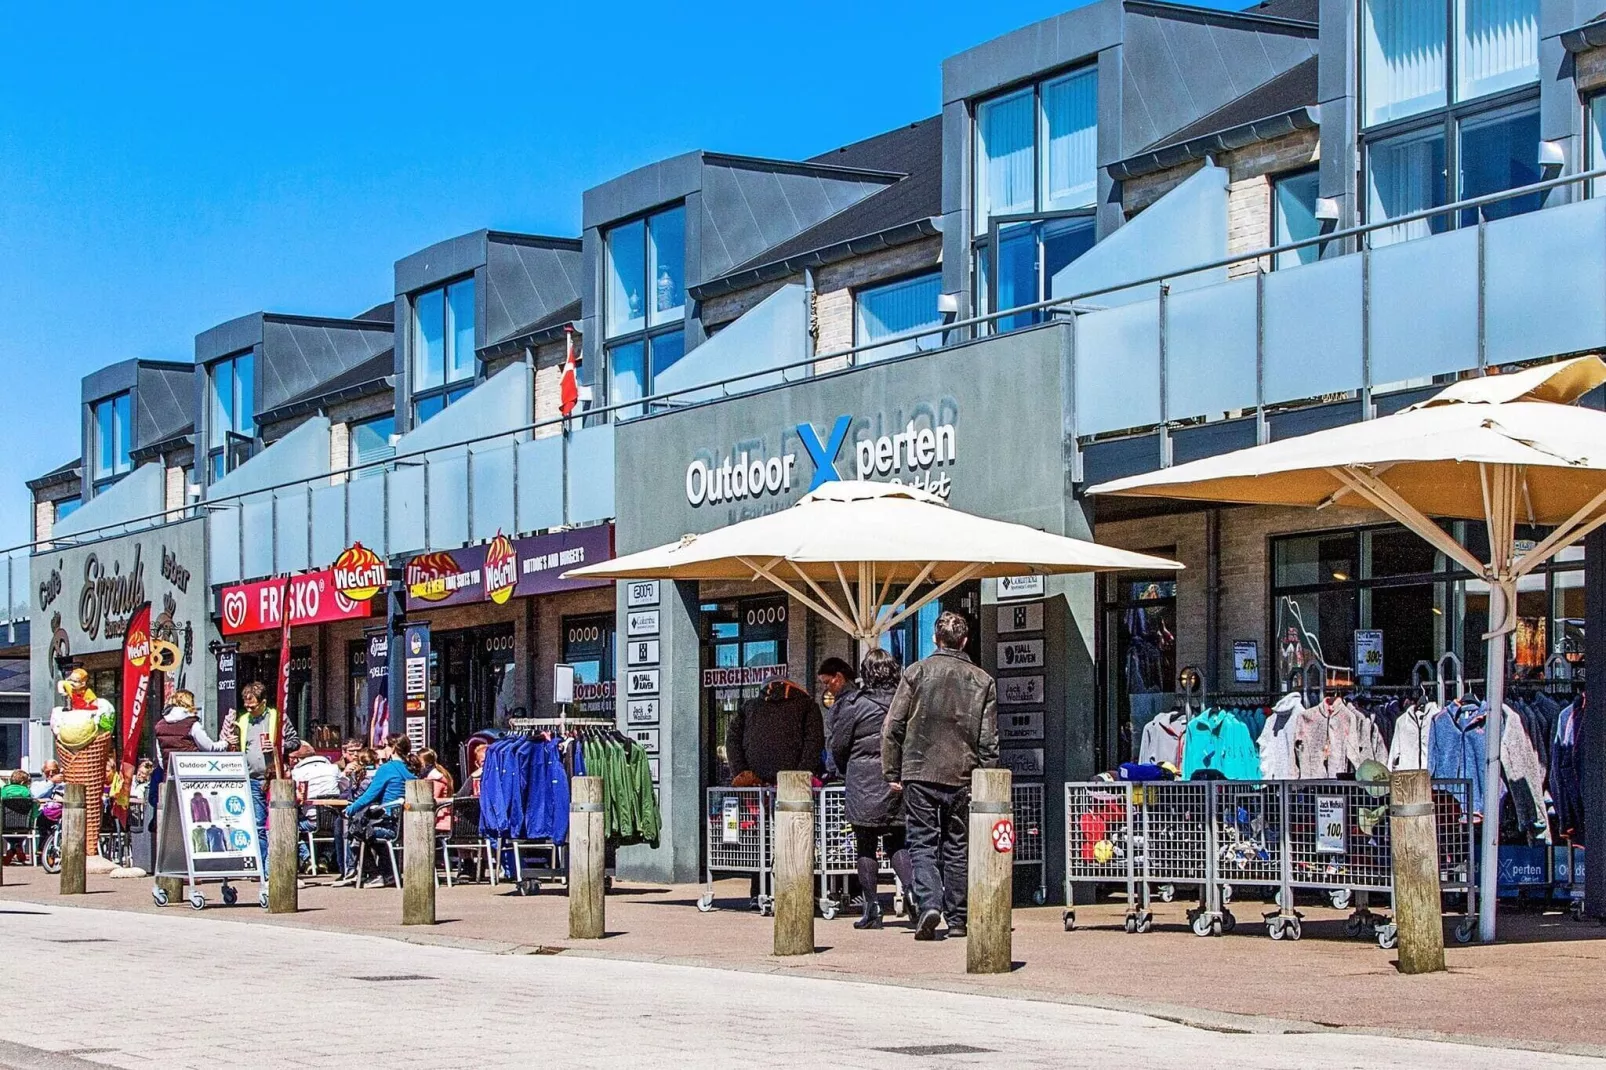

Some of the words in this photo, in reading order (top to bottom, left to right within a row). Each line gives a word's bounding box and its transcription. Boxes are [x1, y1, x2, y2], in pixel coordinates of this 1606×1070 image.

[686, 452, 795, 505] Outdoor
[856, 420, 956, 481] perten
[334, 564, 386, 590] WeGrill
[485, 556, 517, 592] WeGrill
[127, 641, 150, 661] WeGrill
[704, 668, 750, 687] BURGER
[751, 664, 786, 684] MENU
[1512, 864, 1541, 876] perten
